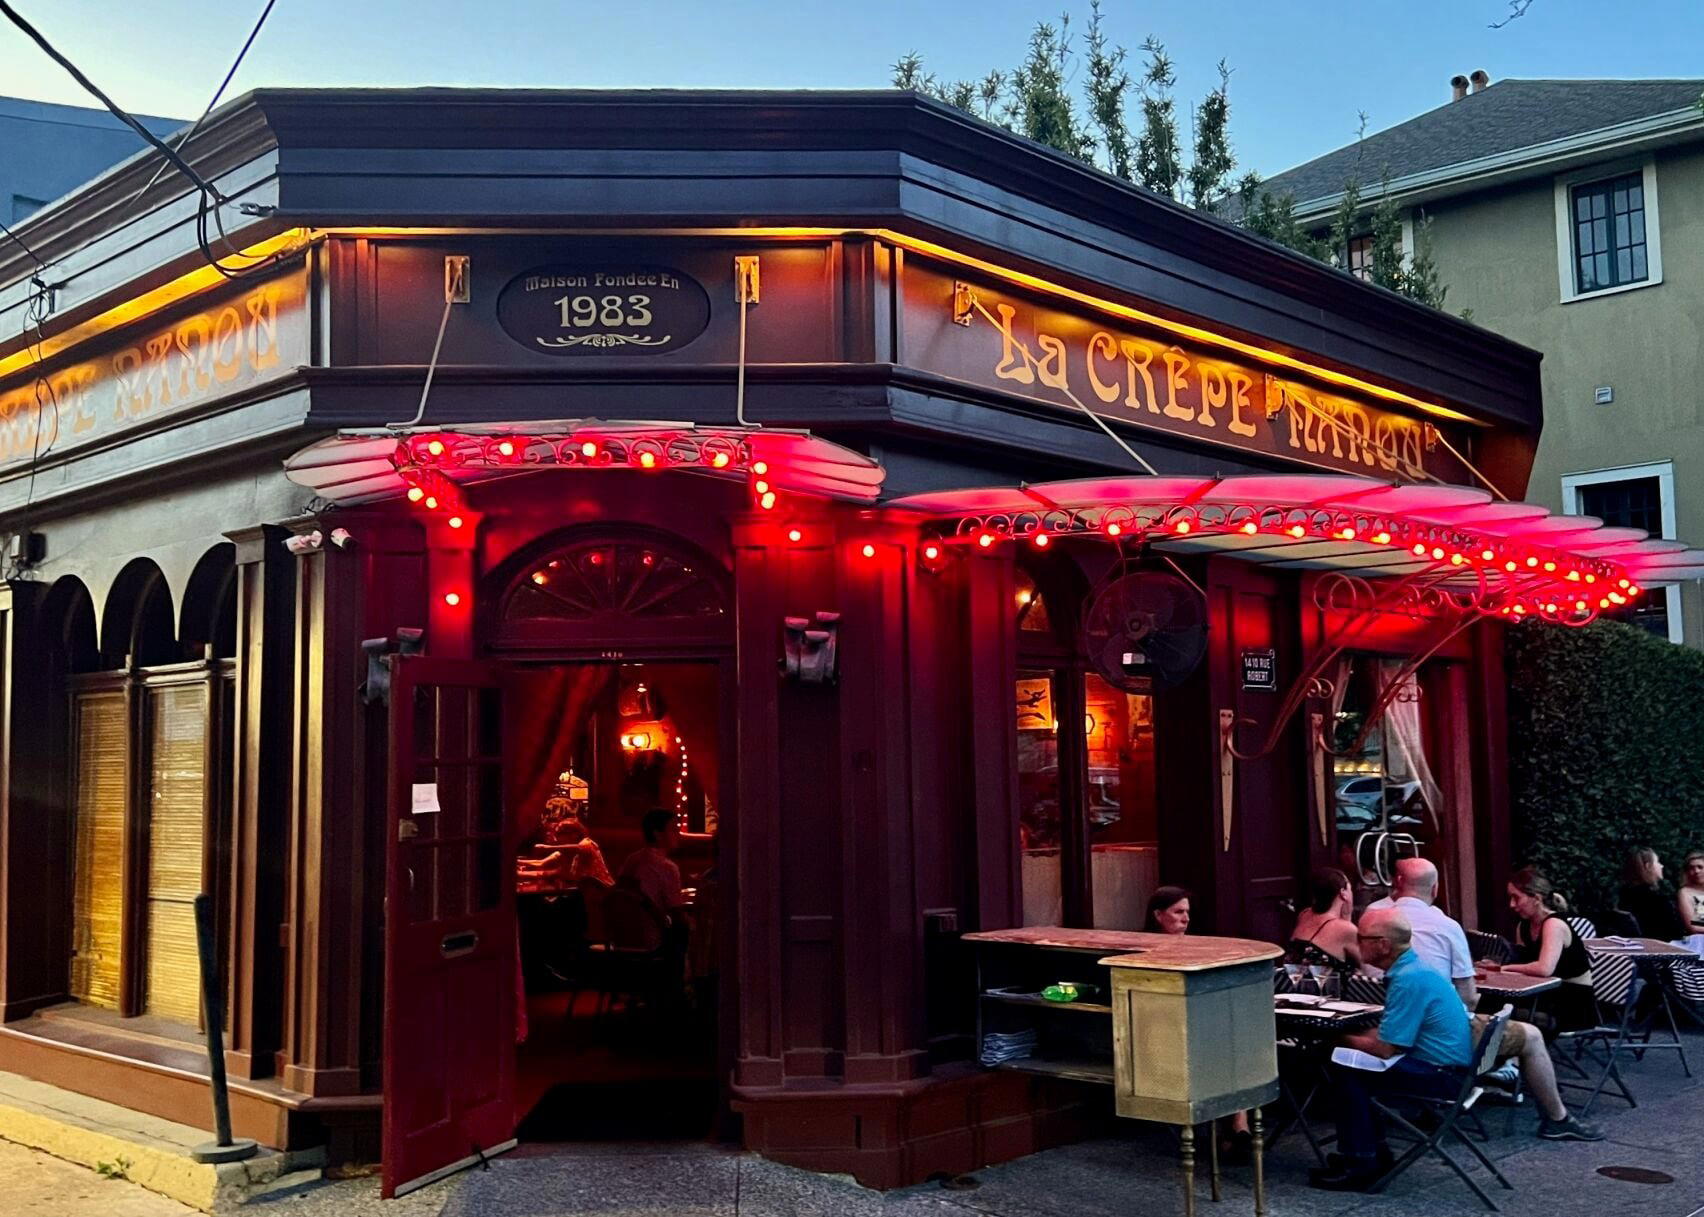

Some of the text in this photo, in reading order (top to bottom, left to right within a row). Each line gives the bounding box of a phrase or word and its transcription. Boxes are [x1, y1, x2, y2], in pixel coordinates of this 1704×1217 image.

[525, 275, 587, 291] Maison
[660, 273, 680, 290] En
[554, 294, 652, 328] 1983
[995, 303, 1069, 389] La
[1086, 331, 1257, 438] CRÊPE
